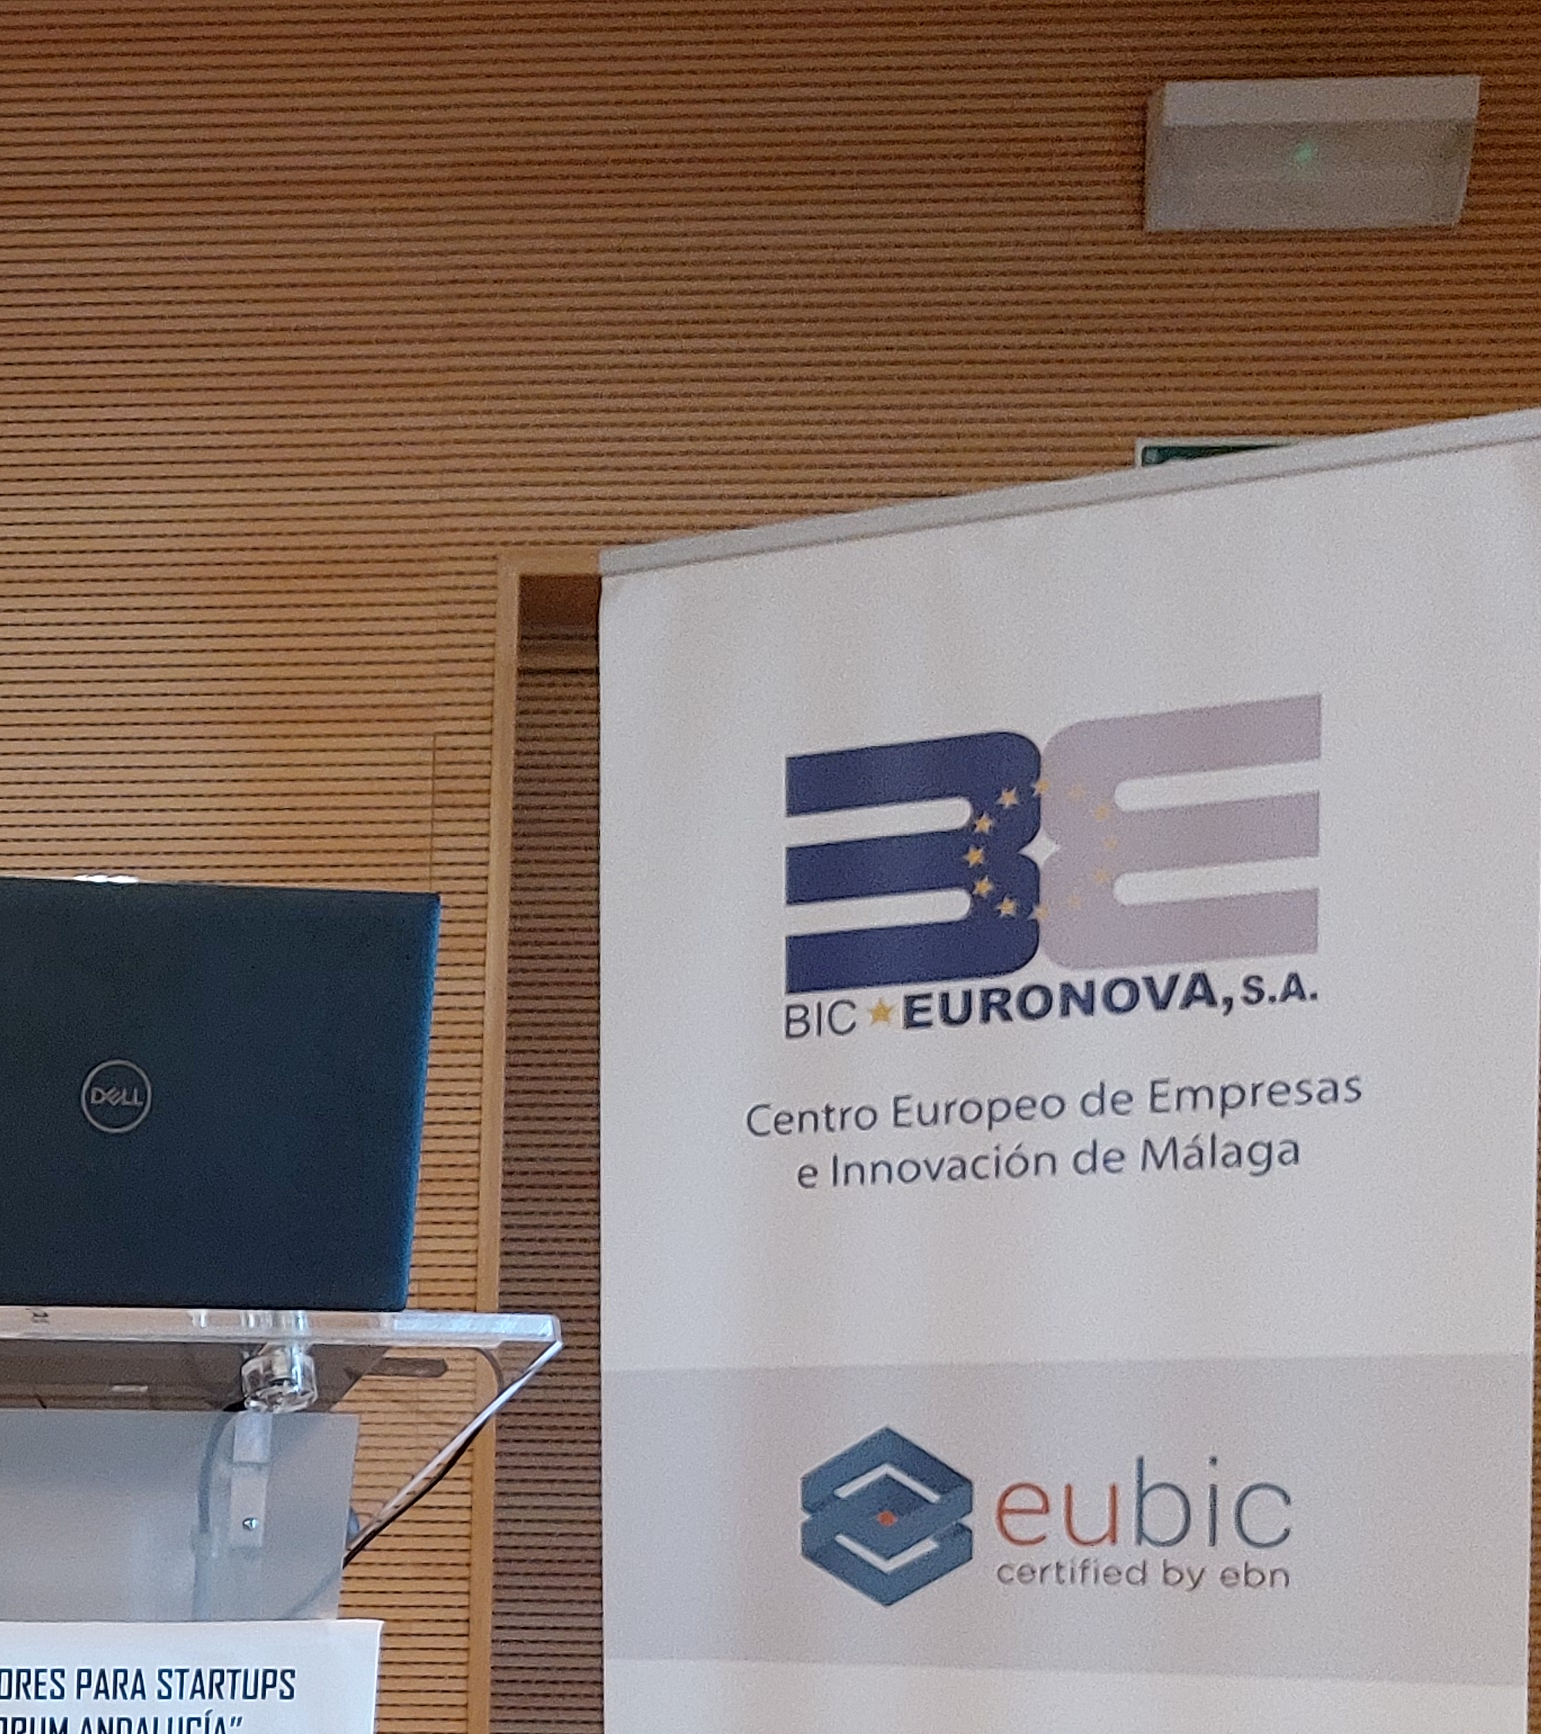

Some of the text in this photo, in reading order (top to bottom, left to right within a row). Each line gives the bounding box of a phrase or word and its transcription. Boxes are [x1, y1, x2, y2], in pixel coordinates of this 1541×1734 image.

[784, 999, 857, 1040] BIC
[90, 1086, 144, 1107] DELL
[746, 1074, 1363, 1137] Centro Europeo de Empresas
[797, 1132, 1301, 1189] e Innovación de Málaga
[994, 1455, 1293, 1549] eubic
[996, 1558, 1291, 1591] certified by ebn
[75, 1668, 147, 1701] PARA
[156, 1668, 297, 1701] STARTUPS
